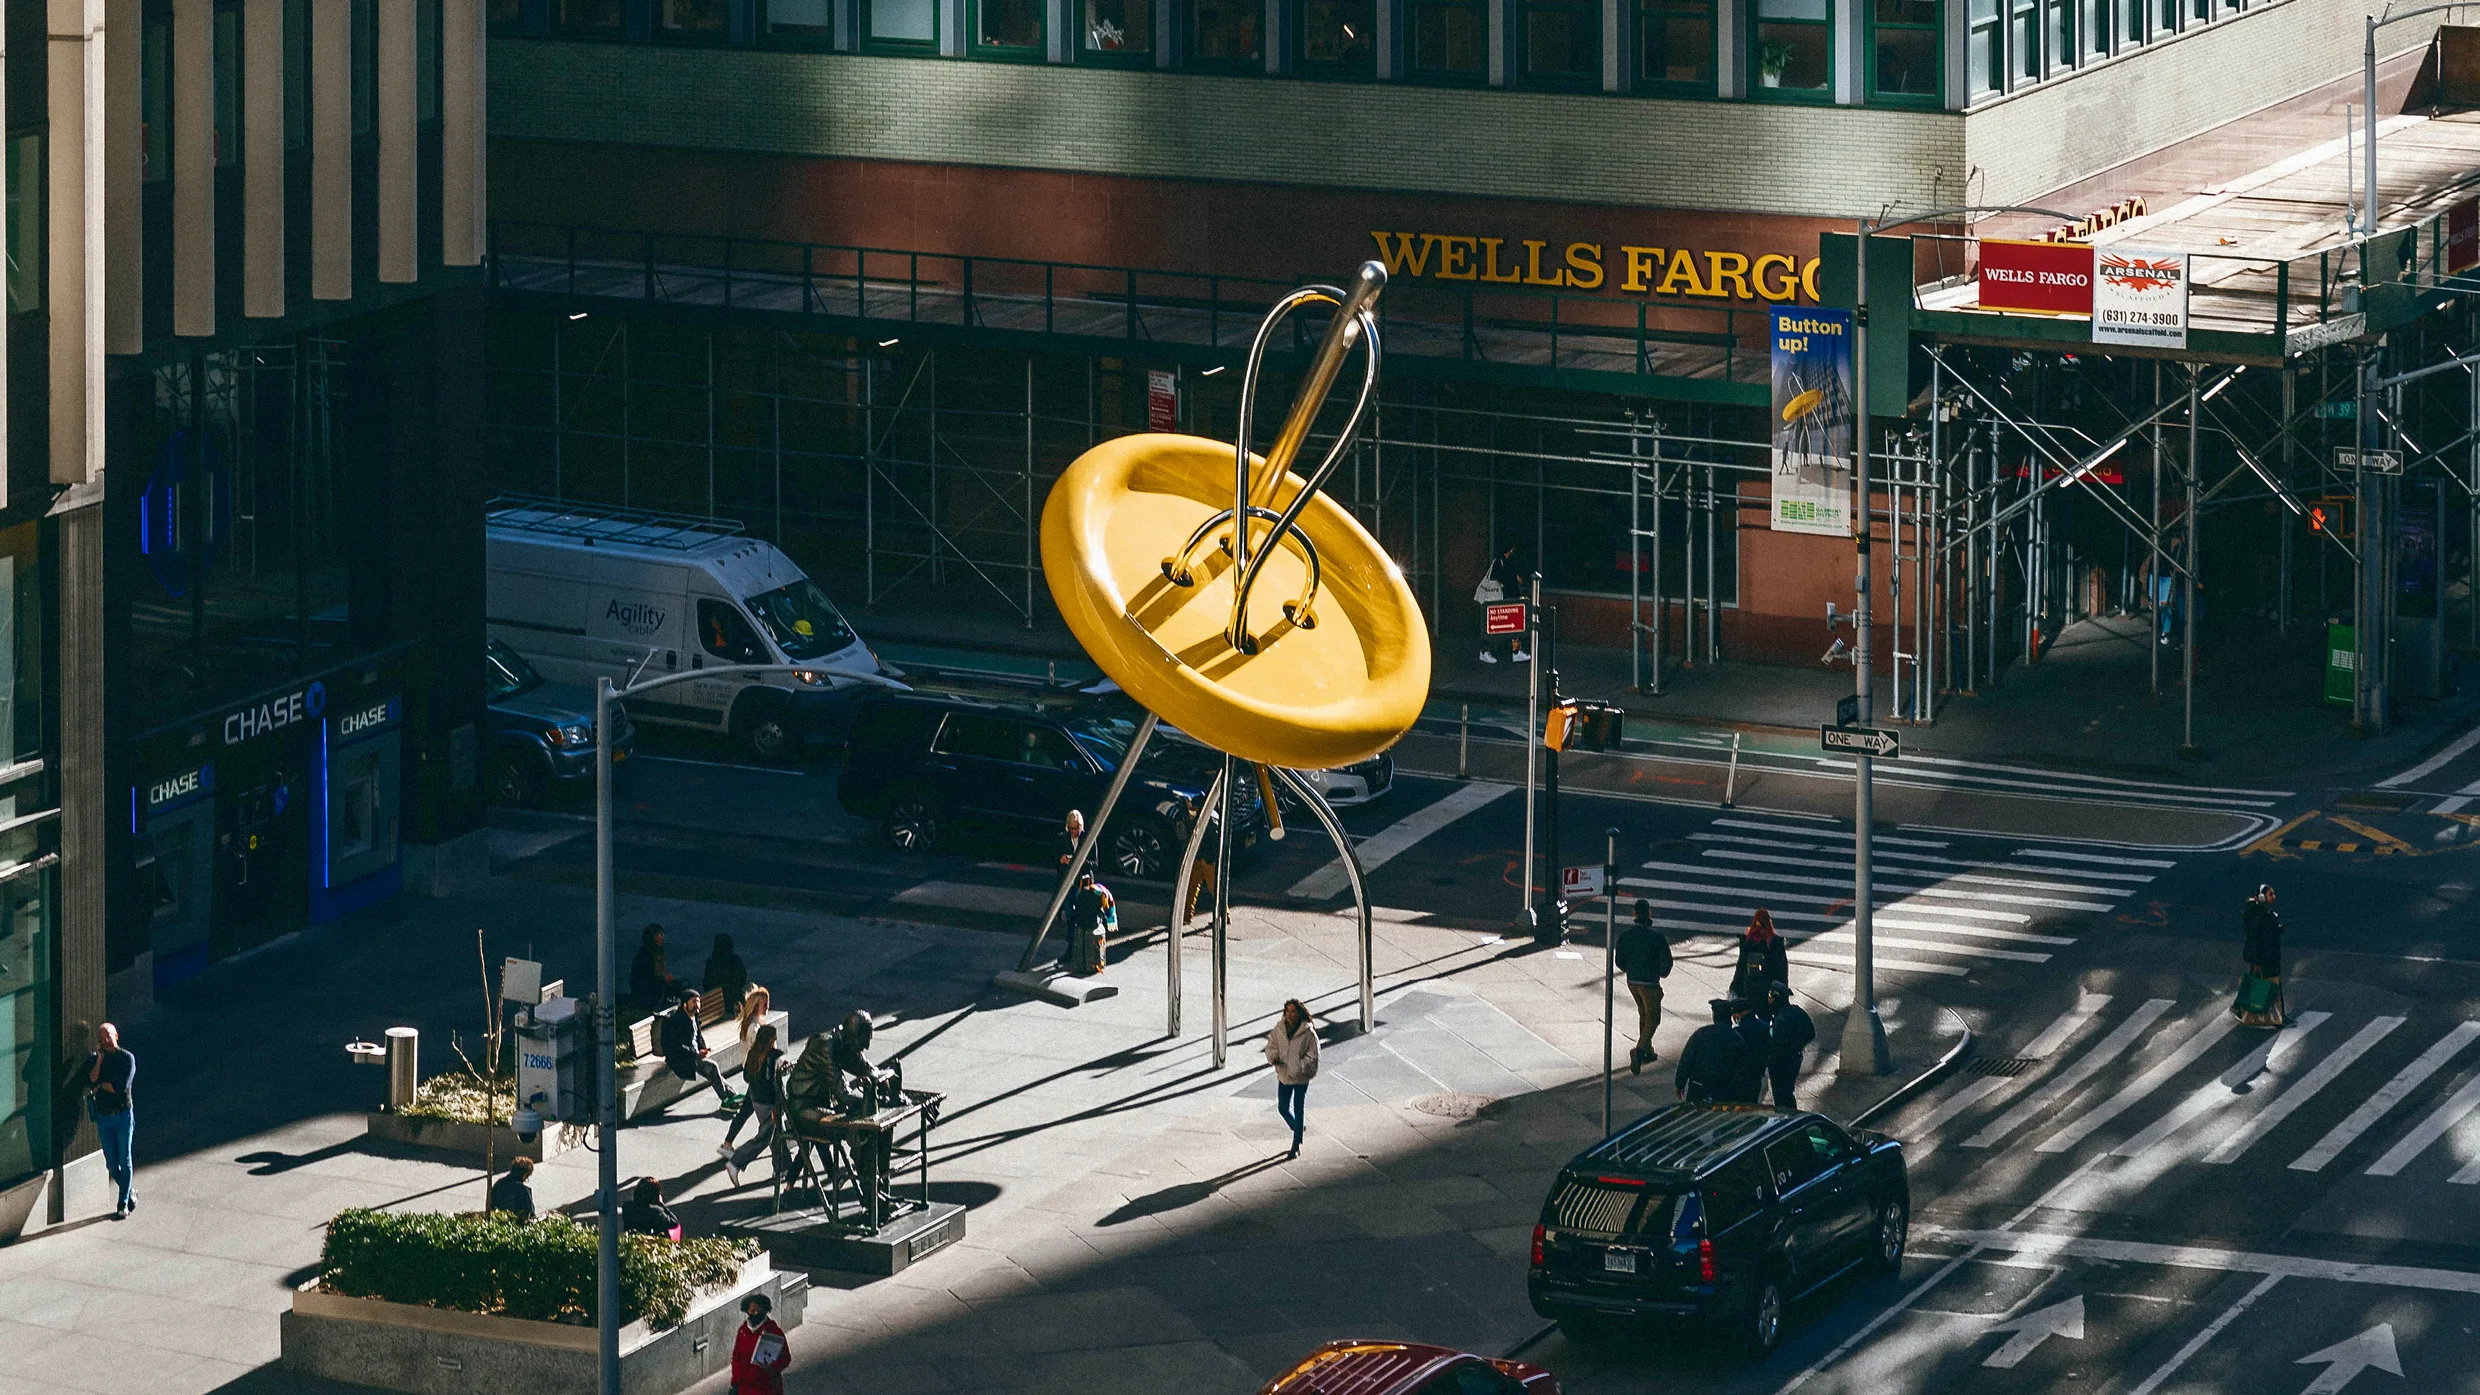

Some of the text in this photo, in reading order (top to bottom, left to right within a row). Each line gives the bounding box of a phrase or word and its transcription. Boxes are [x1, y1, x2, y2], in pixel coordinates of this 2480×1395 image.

[1371, 231, 1604, 288] WELLS
[1985, 268, 2088, 286] WELLS FARGO
[2104, 267, 2176, 280] ARSENAL
[1779, 316, 1842, 336] Button
[2102, 310, 2178, 326] (631) 274-3900
[2098, 326, 2182, 338] www.arsenalscaffold.com
[1779, 336, 1808, 354] up!
[2338, 403, 2350, 417] 39
[2344, 454, 2392, 467] ON WAY
[606, 599, 665, 630] Agility
[224, 691, 303, 746] CHASE
[341, 703, 387, 735] CHASE
[1828, 732, 1889, 749] ONE WAY
[150, 771, 198, 804] CHASE
